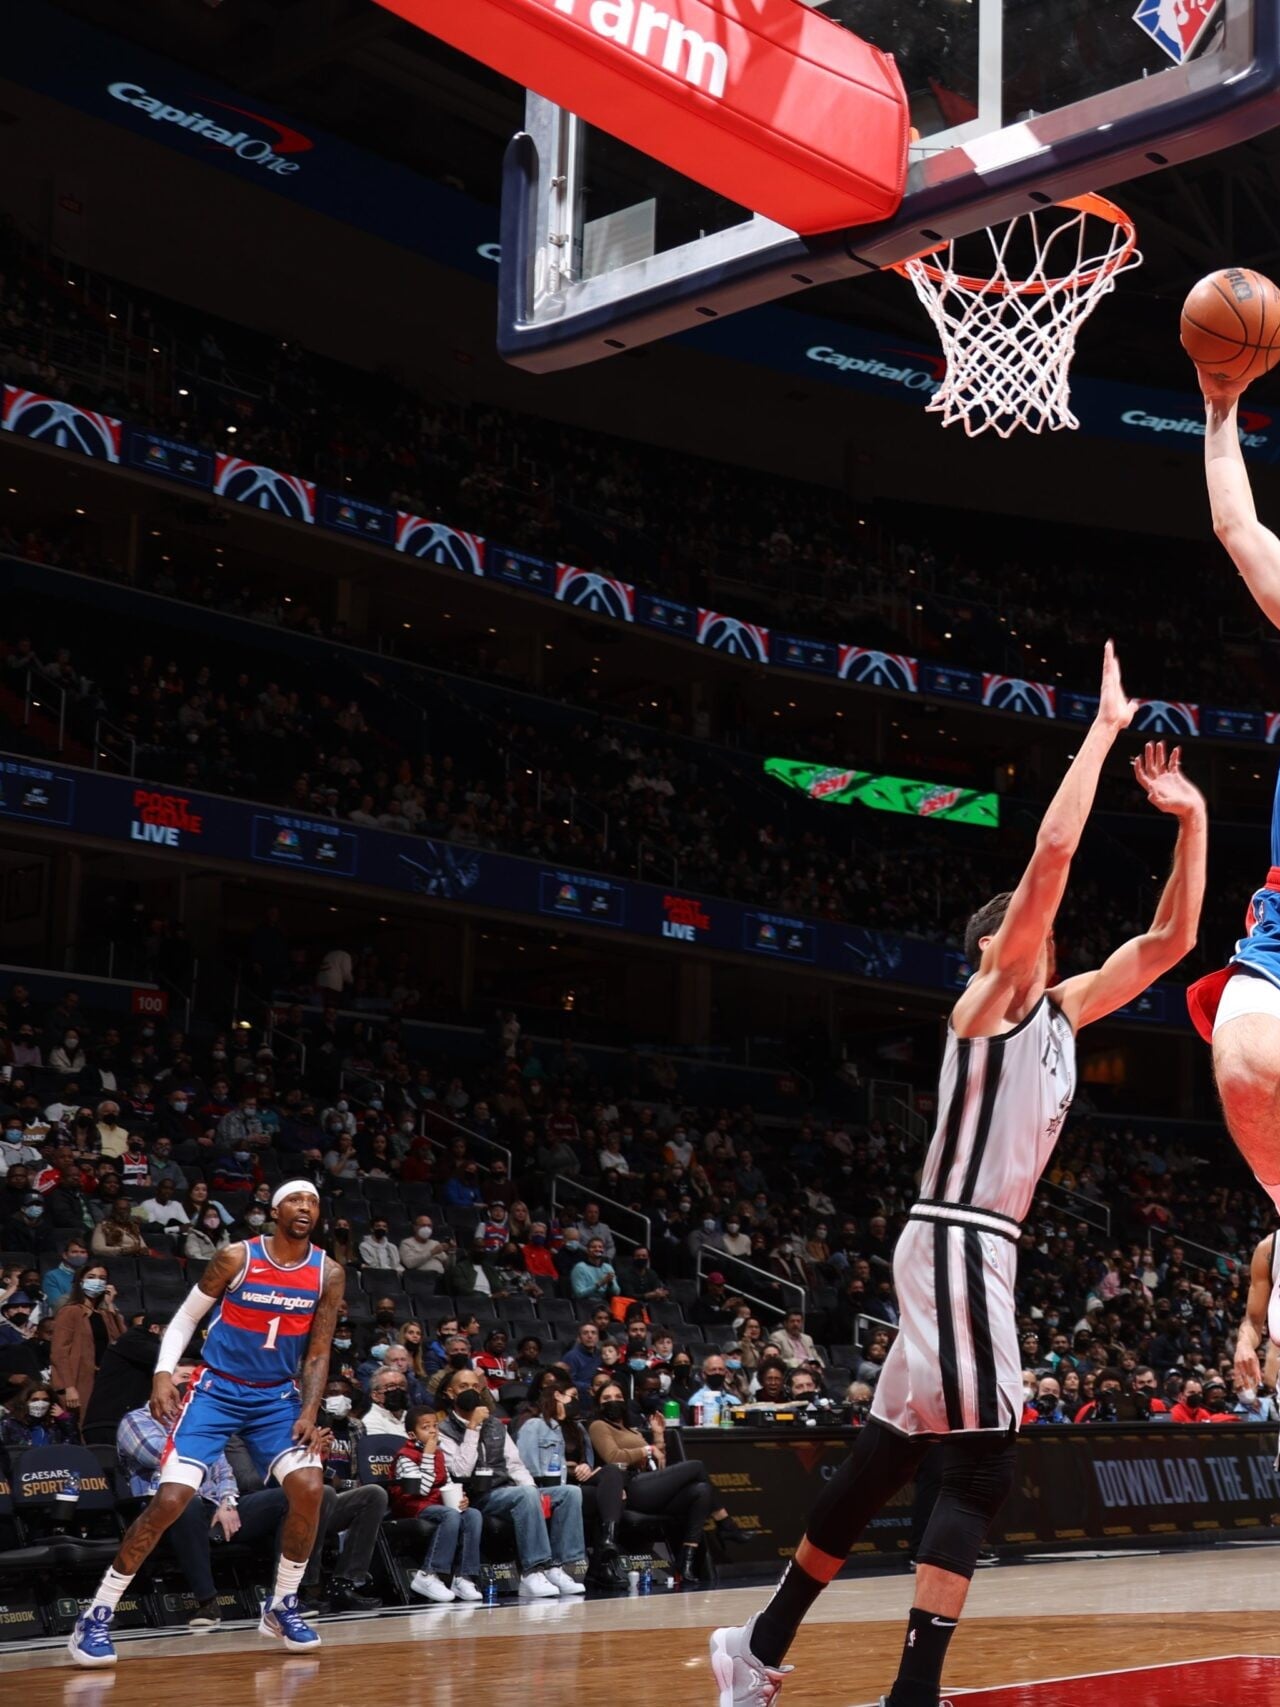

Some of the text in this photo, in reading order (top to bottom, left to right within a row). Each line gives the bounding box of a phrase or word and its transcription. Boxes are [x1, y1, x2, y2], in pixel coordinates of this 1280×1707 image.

[554, 0, 728, 98] arm
[130, 821, 180, 847] LIVE
[662, 920, 696, 942] LIVE
[139, 996, 163, 1012] 100
[241, 1290, 315, 1310] washington
[262, 1315, 281, 1349] 1
[21, 1469, 71, 1482] CAESARS
[1093, 1457, 1209, 1508] DOWNLOAD
[1204, 1455, 1250, 1502] THE
